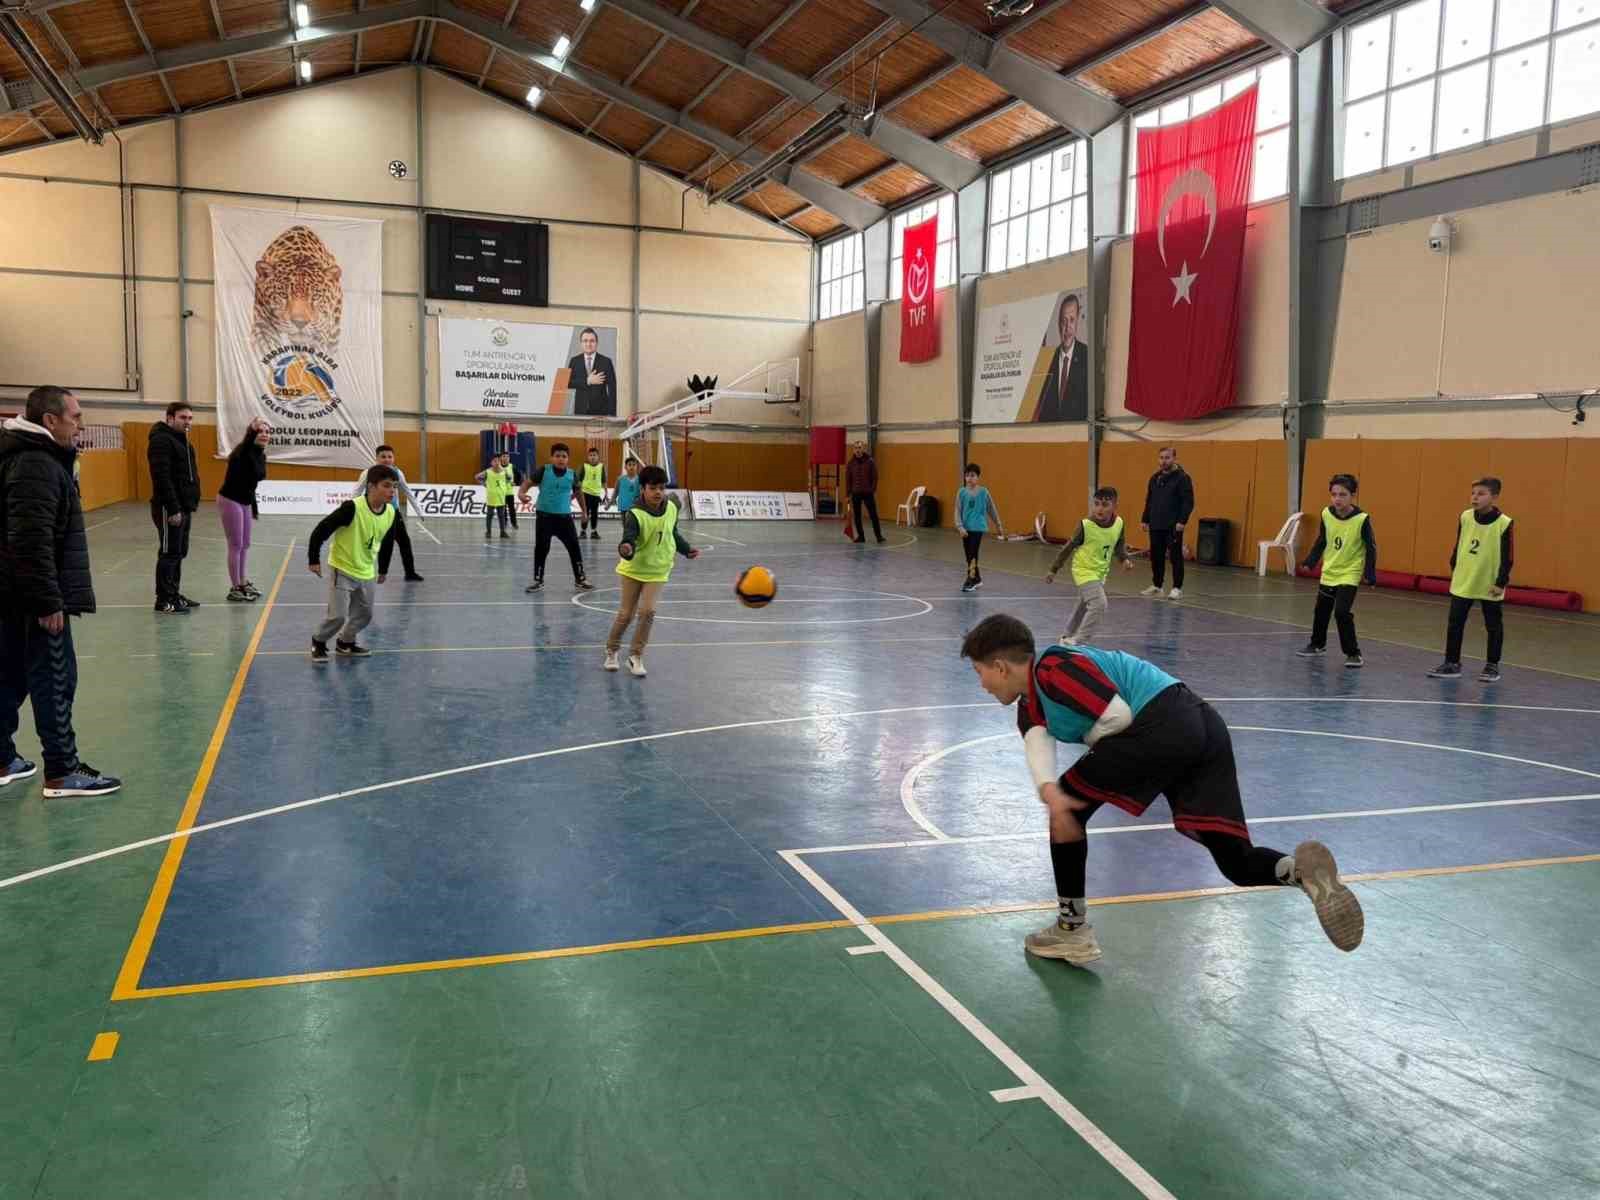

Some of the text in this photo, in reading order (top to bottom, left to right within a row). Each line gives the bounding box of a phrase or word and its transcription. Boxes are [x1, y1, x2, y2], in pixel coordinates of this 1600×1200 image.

[502, 288, 521, 296] GUEST
[909, 305, 926, 328] TVF
[455, 370, 545, 382] BAŞARILAR DİLİYORUM
[275, 388, 302, 396] 2022
[261, 394, 307, 420] VOLEYBOL
[270, 427, 295, 435] DOLU
[294, 438, 351, 448] AKADEMİSİ
[411, 486, 476, 504] TAHİR
[1334, 536, 1342, 550] 9
[1469, 539, 1479, 554] 2
[1103, 545, 1110, 559] 7
